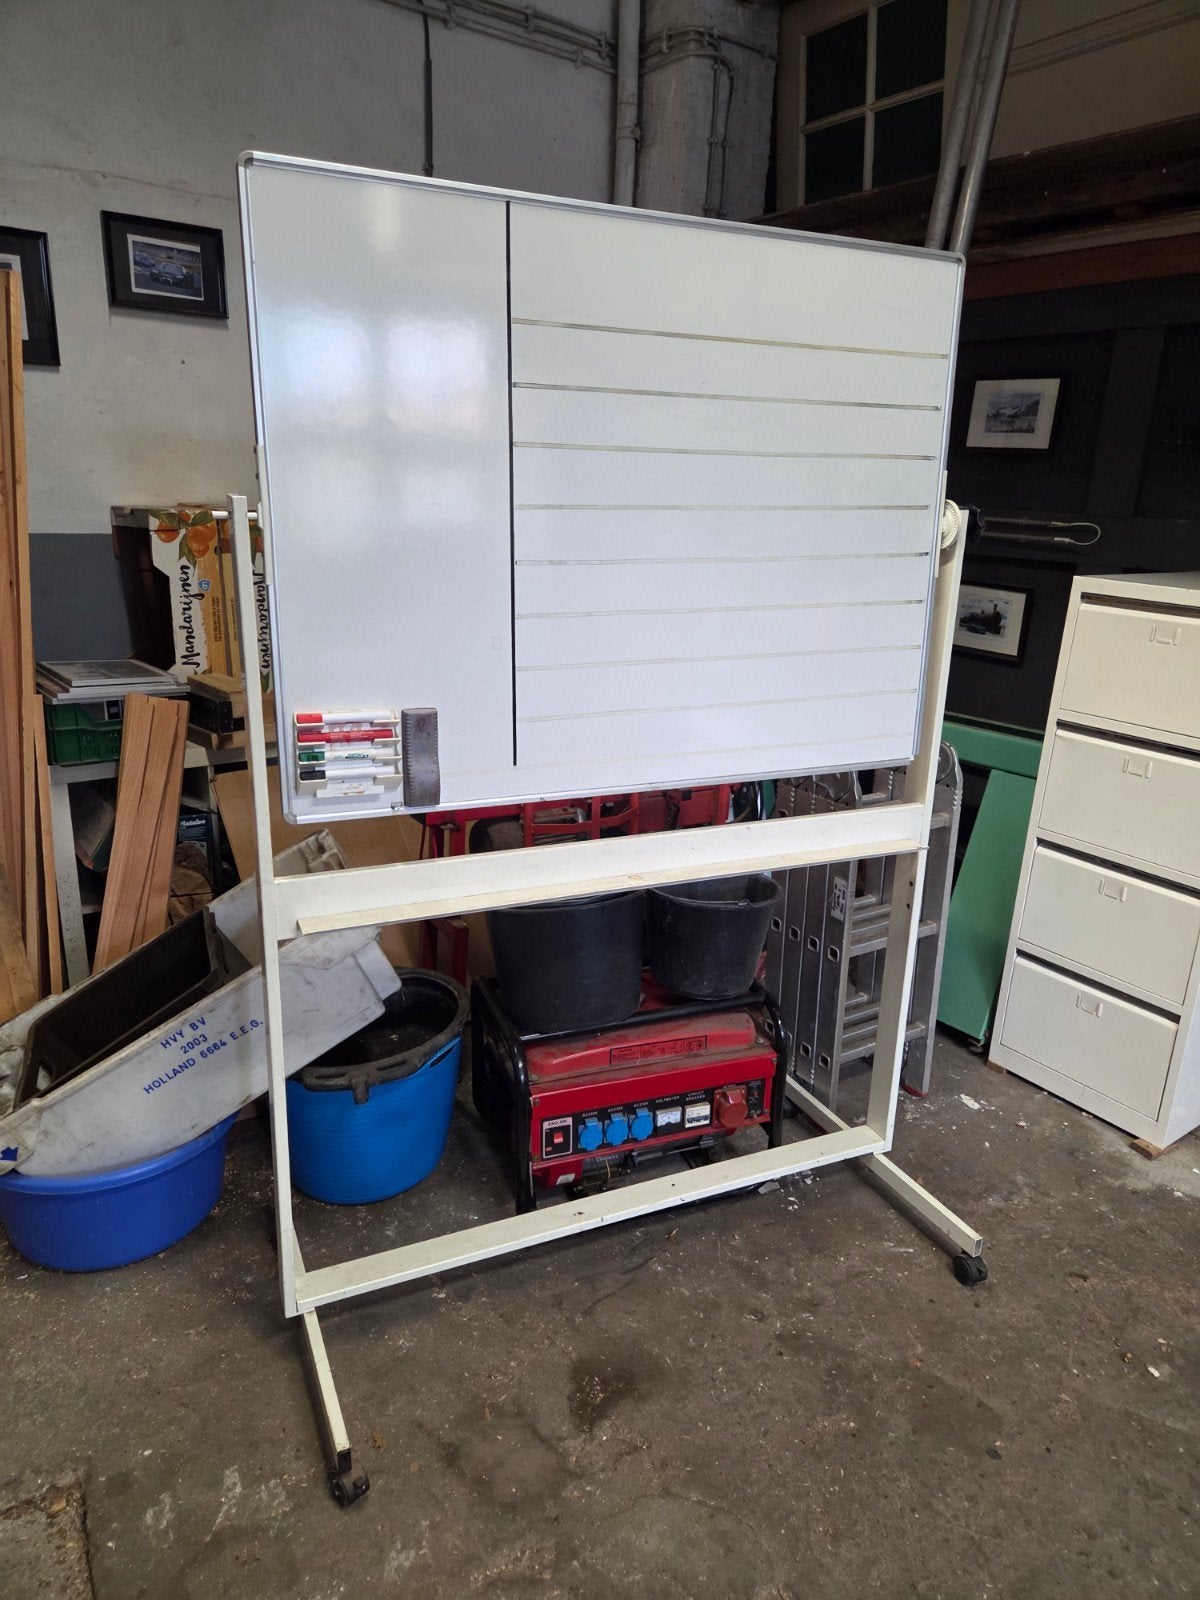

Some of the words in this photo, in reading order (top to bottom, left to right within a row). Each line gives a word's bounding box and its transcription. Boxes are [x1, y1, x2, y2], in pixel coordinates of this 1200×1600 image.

[179, 565, 205, 669] Mandarijnen
[160, 1029, 185, 1050] HVY
[189, 1016, 207, 1031] BV
[180, 1033, 208, 1054] 2003
[143, 1057, 197, 1095] HOLLAND
[229, 1019, 263, 1041] E.E.G.
[655, 1095, 680, 1103] VOLTMETER
